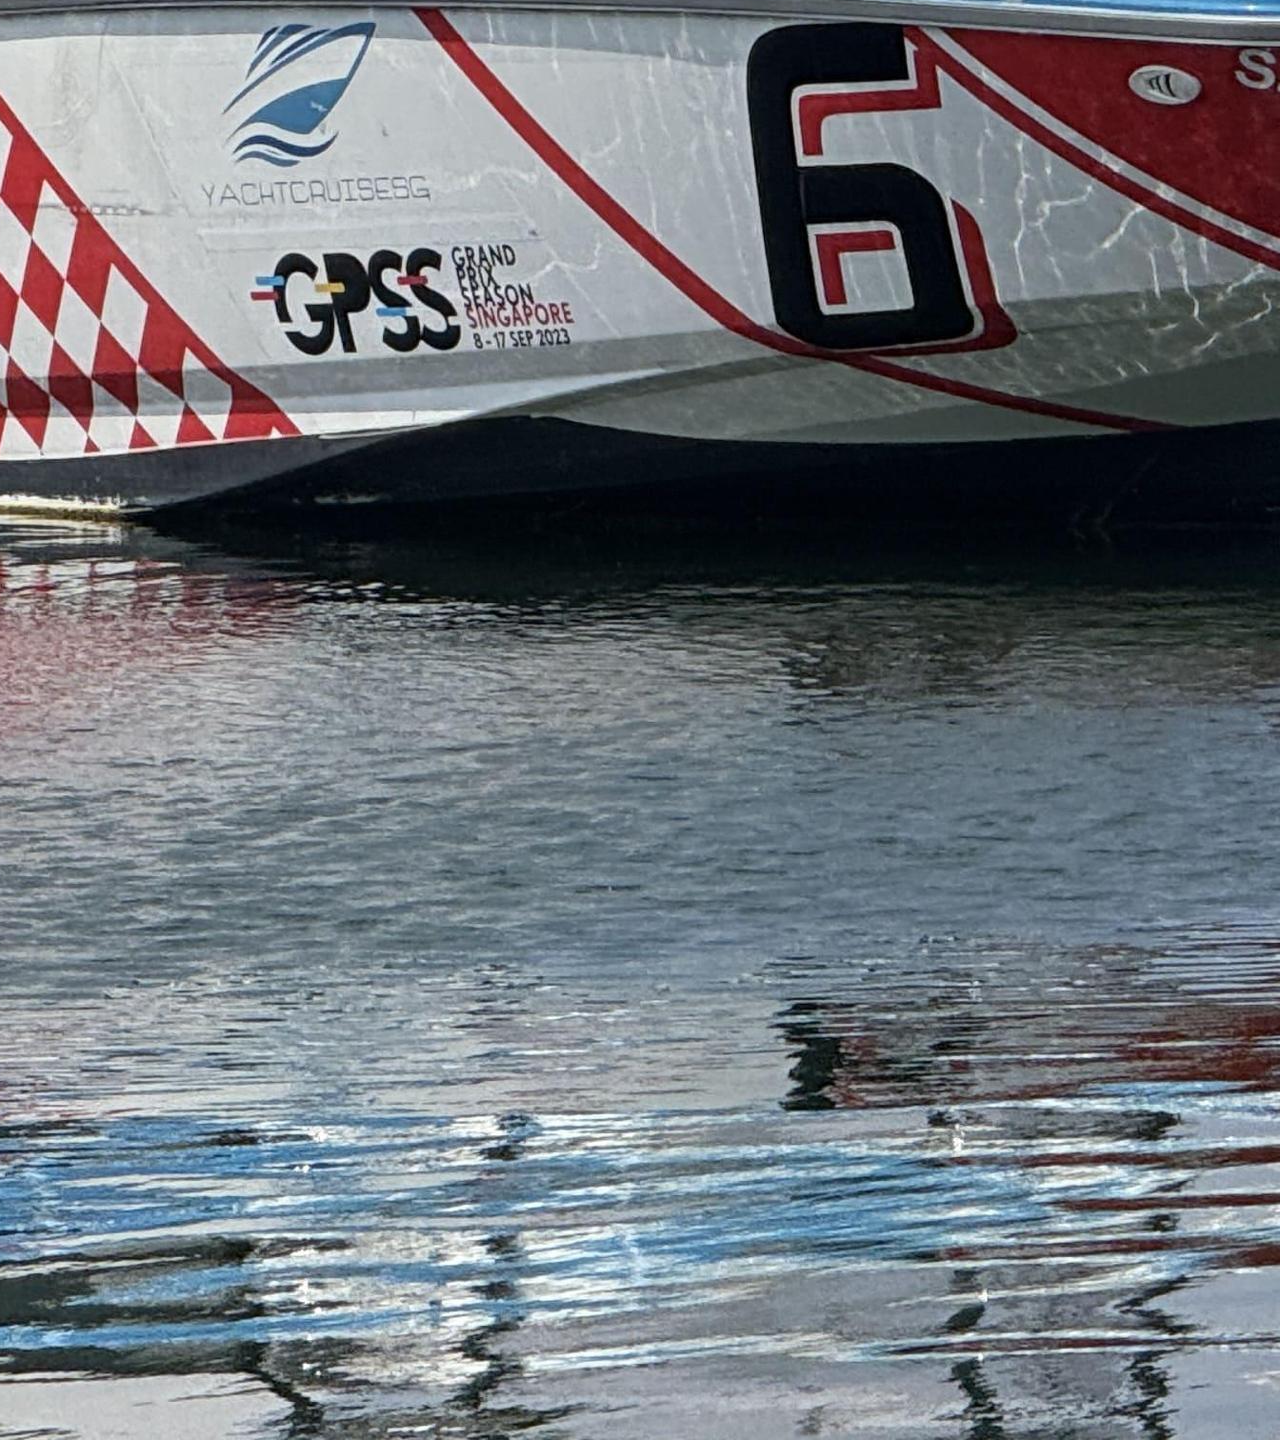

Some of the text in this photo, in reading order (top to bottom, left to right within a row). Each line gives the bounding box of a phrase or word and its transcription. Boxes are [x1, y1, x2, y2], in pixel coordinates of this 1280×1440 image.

[201, 176, 431, 207] YACHTCRUISESG
[747, 21, 978, 351] 6
[451, 244, 516, 268] GRAND
[272, 247, 461, 356] GPSS
[461, 283, 535, 310] SEASON
[466, 302, 575, 329] SINGAPORE
[510, 330, 533, 347] SEP
[536, 327, 570, 346] 2023
